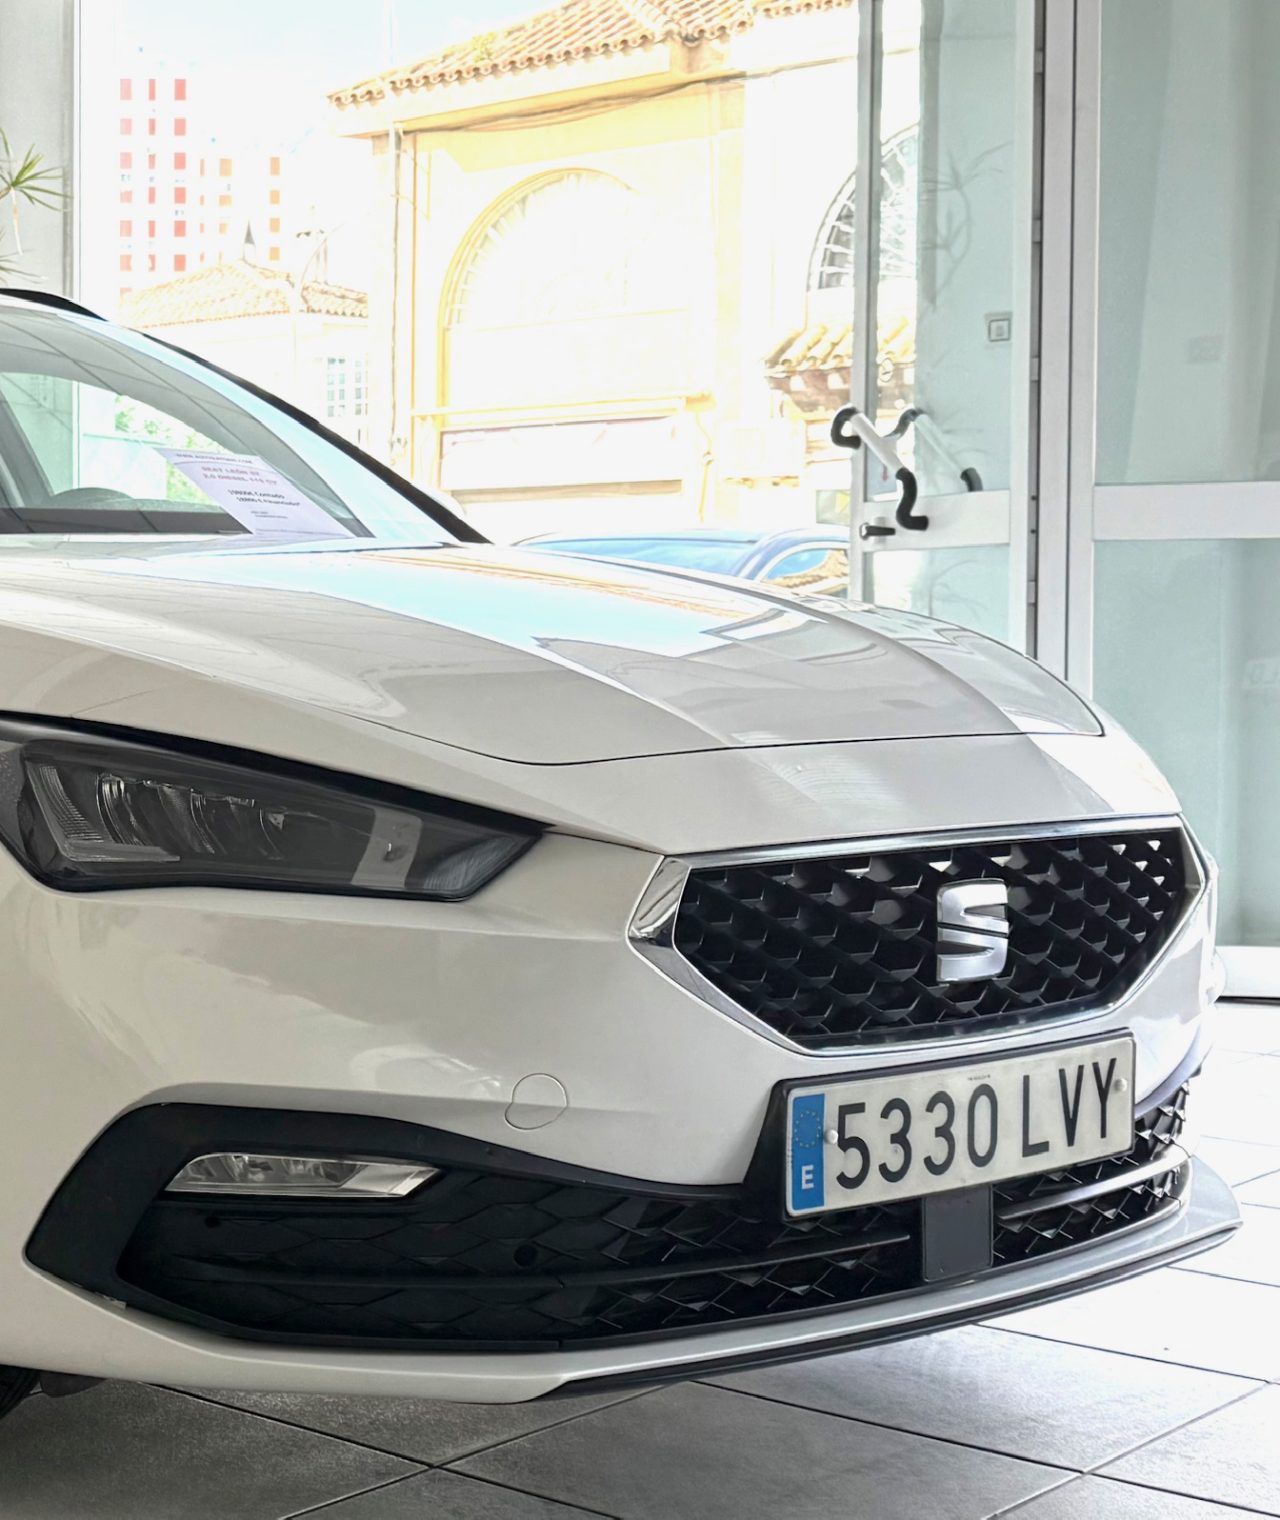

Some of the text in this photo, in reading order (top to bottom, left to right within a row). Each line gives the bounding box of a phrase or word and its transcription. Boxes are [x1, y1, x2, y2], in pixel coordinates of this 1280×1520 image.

[835, 1058, 1117, 1190] 5330 LVY
[801, 1164, 814, 1189] E
